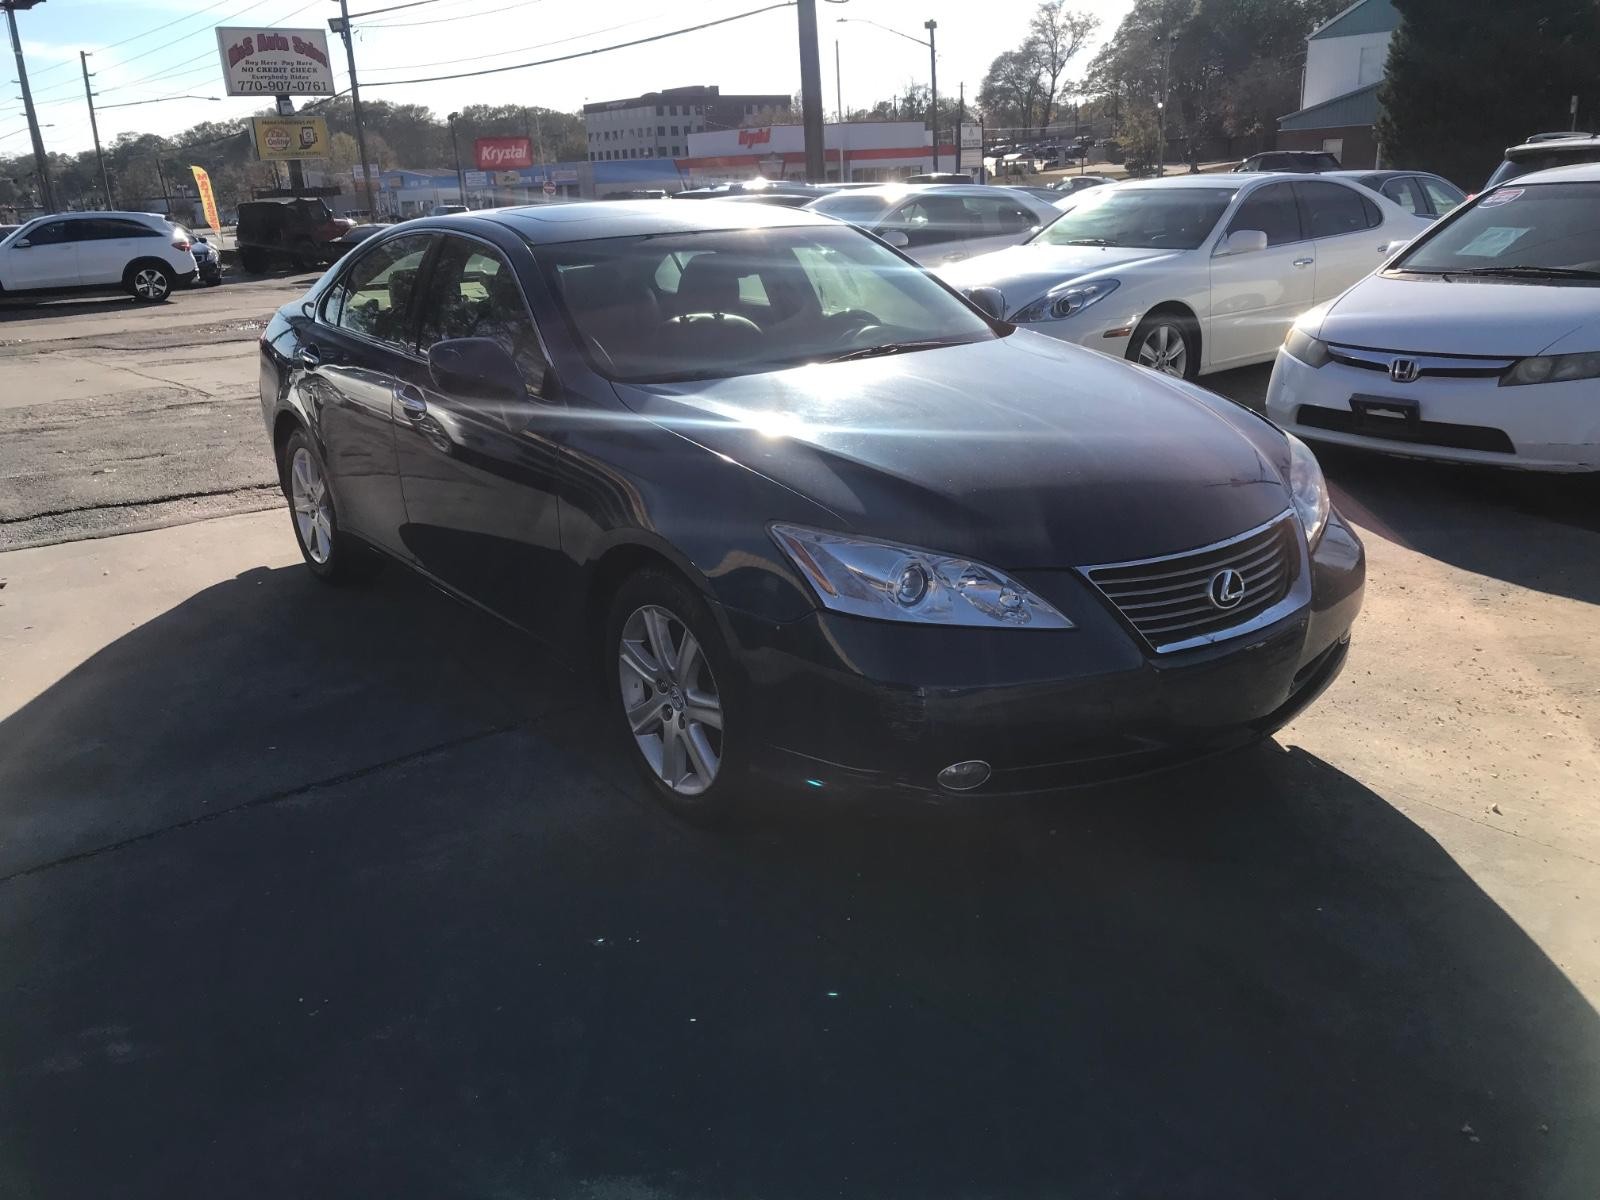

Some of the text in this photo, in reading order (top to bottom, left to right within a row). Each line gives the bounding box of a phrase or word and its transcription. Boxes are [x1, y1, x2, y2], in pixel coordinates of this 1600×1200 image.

[257, 33, 289, 52] Auto
[238, 80, 327, 92] 770-907-0761
[481, 144, 528, 164] Krystal
